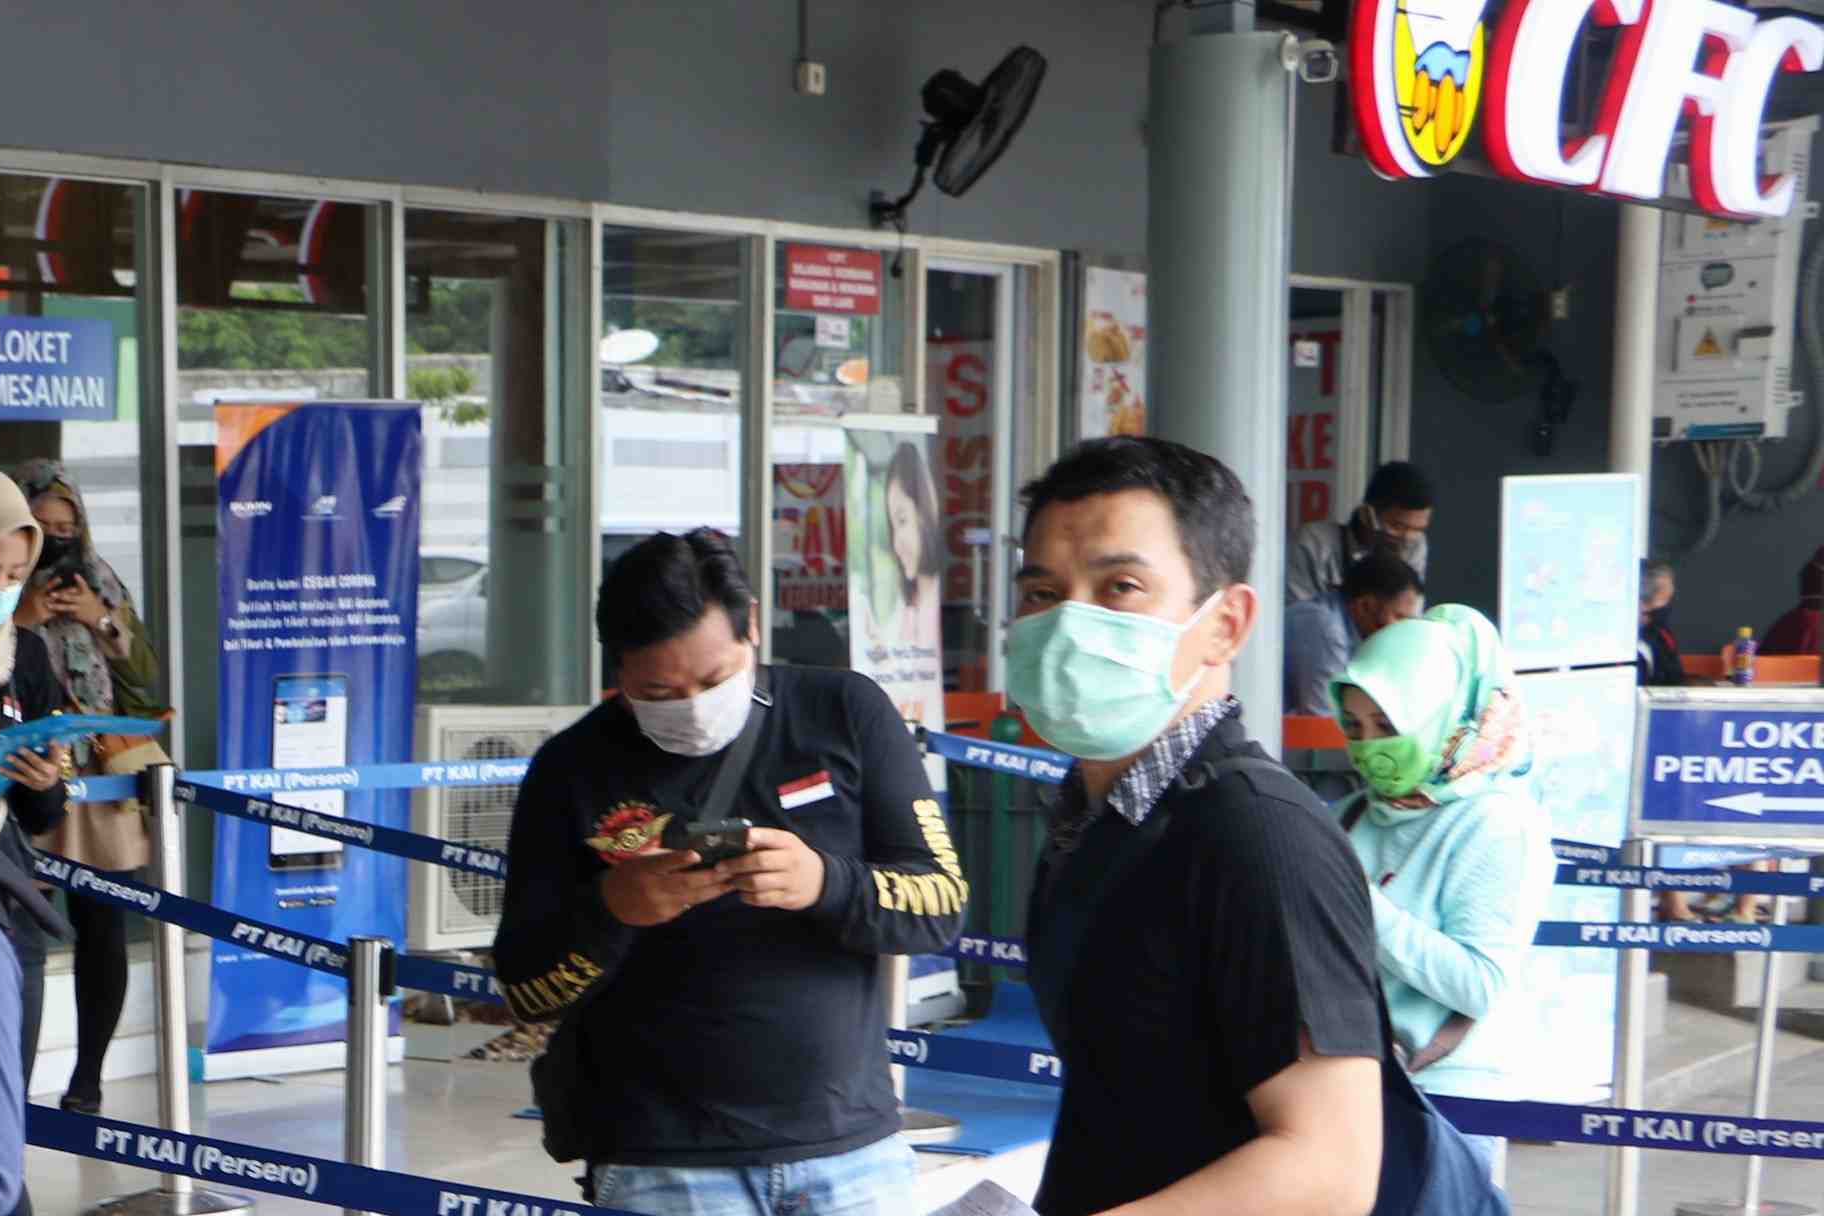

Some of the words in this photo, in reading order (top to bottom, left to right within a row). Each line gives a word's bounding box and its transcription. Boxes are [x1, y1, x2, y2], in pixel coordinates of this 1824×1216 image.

[1484, 0, 1824, 222] CFC
[1721, 721, 1824, 749] LOKE
[965, 746, 992, 764] PT
[993, 752, 1027, 770] KAI
[1654, 755, 1824, 784] PEMESA
[224, 775, 245, 790] PT
[249, 773, 281, 789] KAI
[283, 769, 359, 789] (Persero)
[421, 766, 446, 782] PT
[447, 763, 477, 781] KAI
[247, 799, 269, 817] PT
[270, 805, 301, 825] KAI
[301, 811, 373, 845] (Persero)
[441, 844, 467, 864] PT
[466, 852, 501, 872] KAI
[70, 866, 161, 913] (Persero)
[1577, 868, 1605, 884] PT
[1605, 869, 1642, 886] KAI
[1644, 871, 1733, 891] (Persero)
[232, 922, 266, 944] PT
[263, 931, 306, 957] KAI
[959, 936, 989, 955] PT
[991, 940, 1027, 962] KA
[1580, 924, 1614, 942] PT
[1617, 925, 1661, 943] KAI
[1664, 926, 1773, 947] (Persero)
[452, 970, 484, 992] PT
[1581, 1113, 1625, 1137] PT
[1633, 1116, 1695, 1141] KAI
[1702, 1120, 1824, 1149] (Perser
[95, 1126, 133, 1154] PT
[136, 1134, 187, 1166] KAI
[191, 1143, 318, 1195] (Persero)
